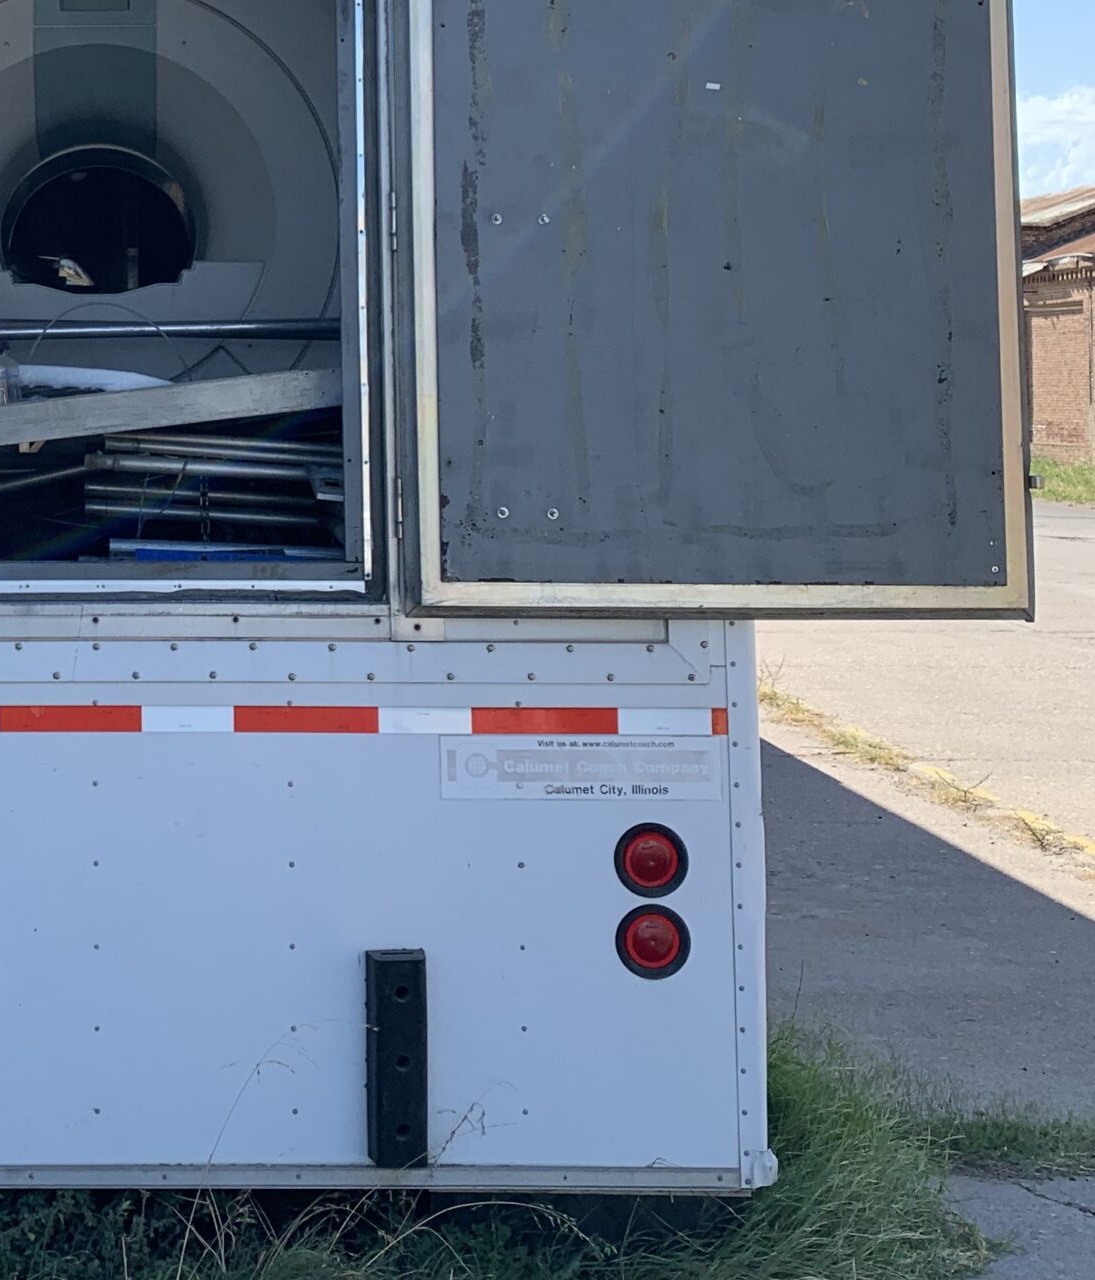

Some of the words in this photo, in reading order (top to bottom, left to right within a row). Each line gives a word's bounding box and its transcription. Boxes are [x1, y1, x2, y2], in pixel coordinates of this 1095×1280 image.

[582, 740, 675, 748] www.calumetcoach.com
[503, 759, 569, 773] Calumet
[576, 759, 626, 773] Coach
[635, 760, 708, 776] Company
[544, 784, 594, 795] Calumet
[599, 784, 627, 797] City,
[631, 784, 669, 795] Illinois
